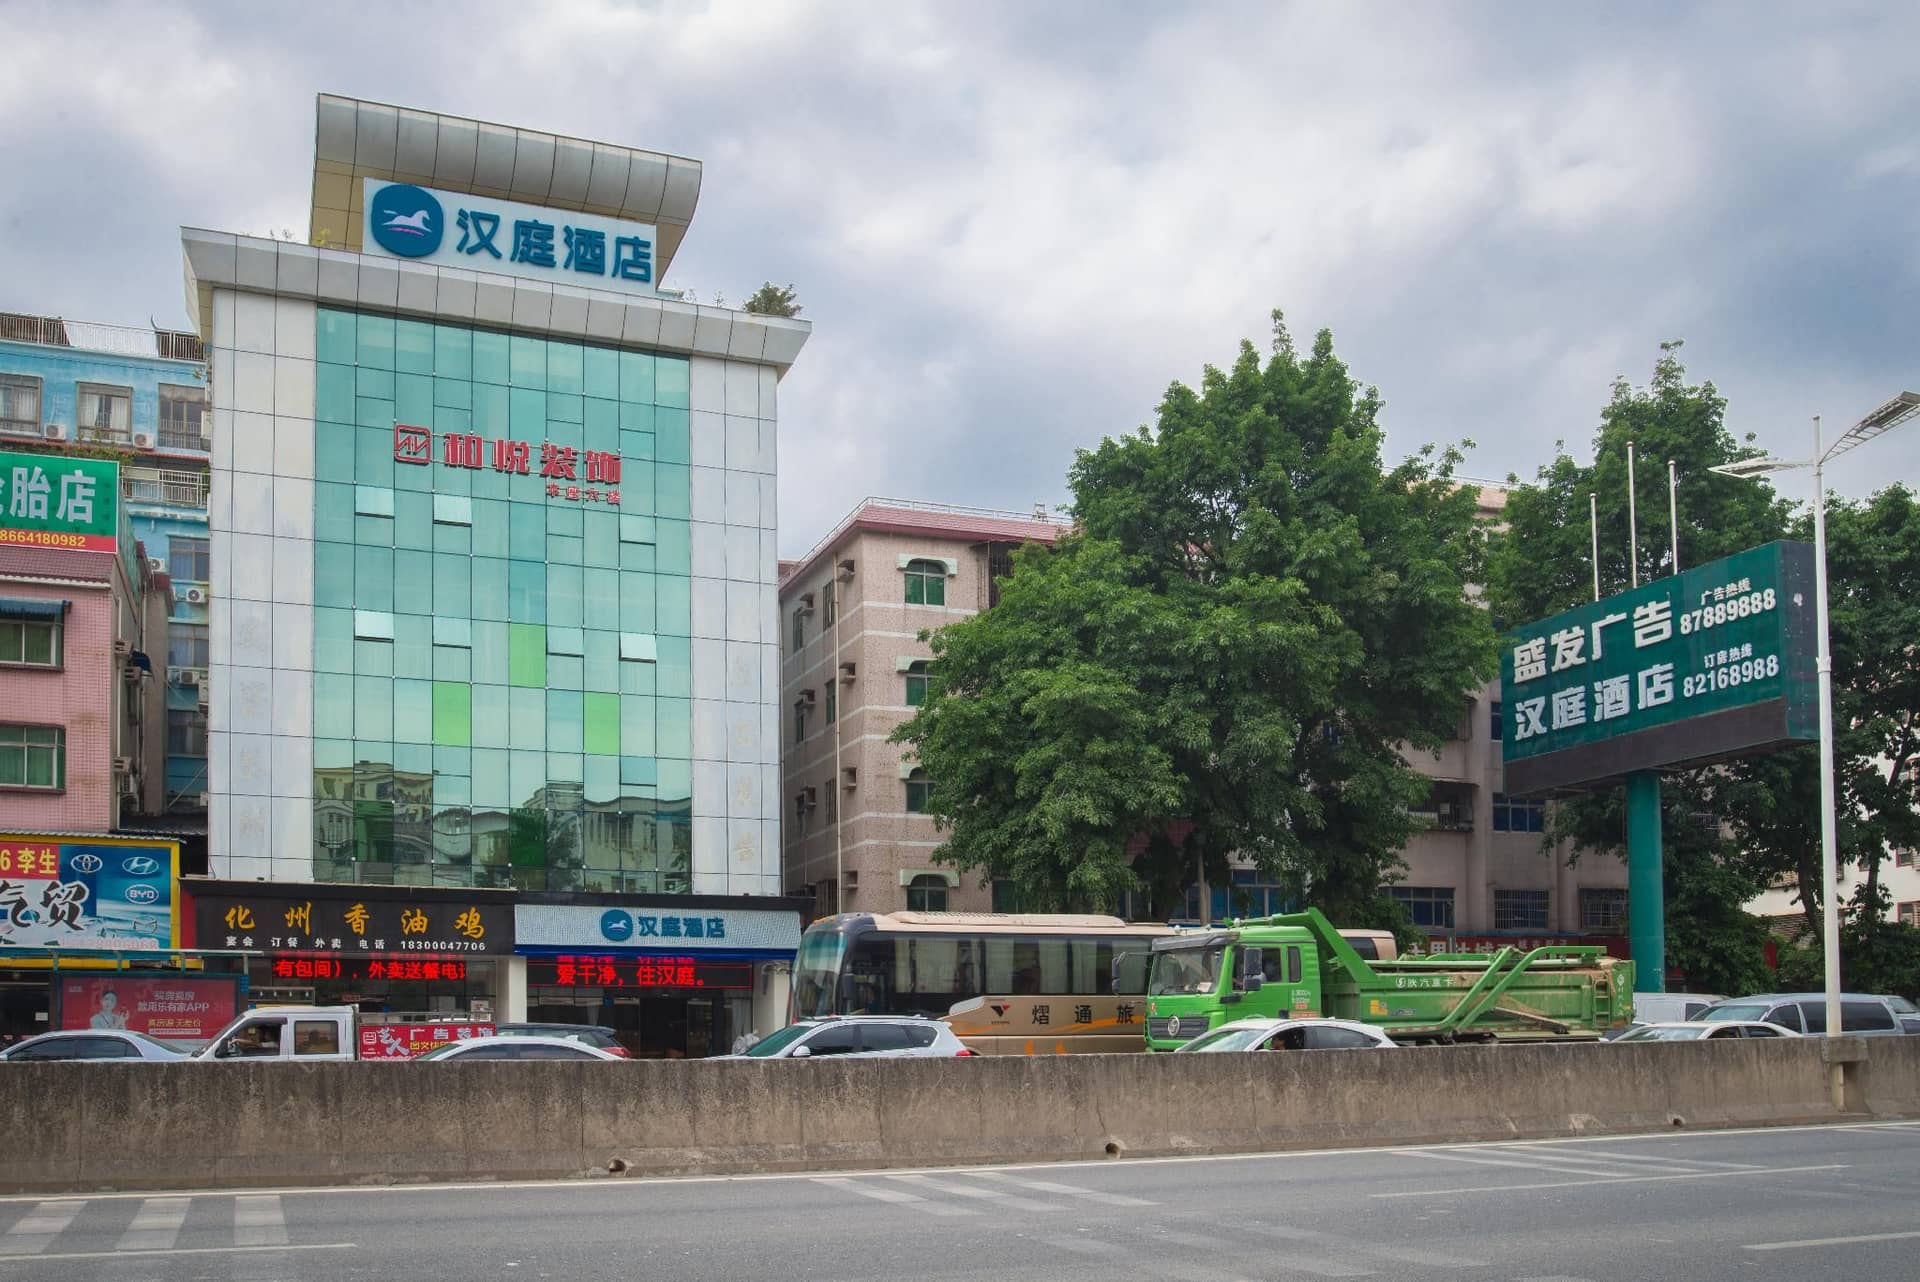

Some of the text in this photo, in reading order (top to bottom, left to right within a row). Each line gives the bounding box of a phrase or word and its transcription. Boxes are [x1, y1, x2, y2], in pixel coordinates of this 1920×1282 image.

[456, 207, 652, 283] 汉庭酒店
[444, 432, 621, 484] 和悦装饰
[0, 466, 96, 524] 胎店
[1701, 577, 1752, 606] 广告热线
[1680, 588, 1777, 636] 87889888
[1513, 600, 1673, 684] 盛发广告
[1704, 643, 1752, 668] 订房热线
[1683, 654, 1779, 699] 82168988
[1514, 662, 1674, 742] 汉庭酒店
[17, 848, 56, 874] 李生
[129, 890, 155, 899] BYD
[224, 901, 485, 939] 化州香油鸡
[638, 916, 725, 938] 汉庭酒店
[225, 936, 486, 951] 宴会 订餐 外卖 电话 18300047706
[1031, 1004, 1135, 1025] 熠通旅
